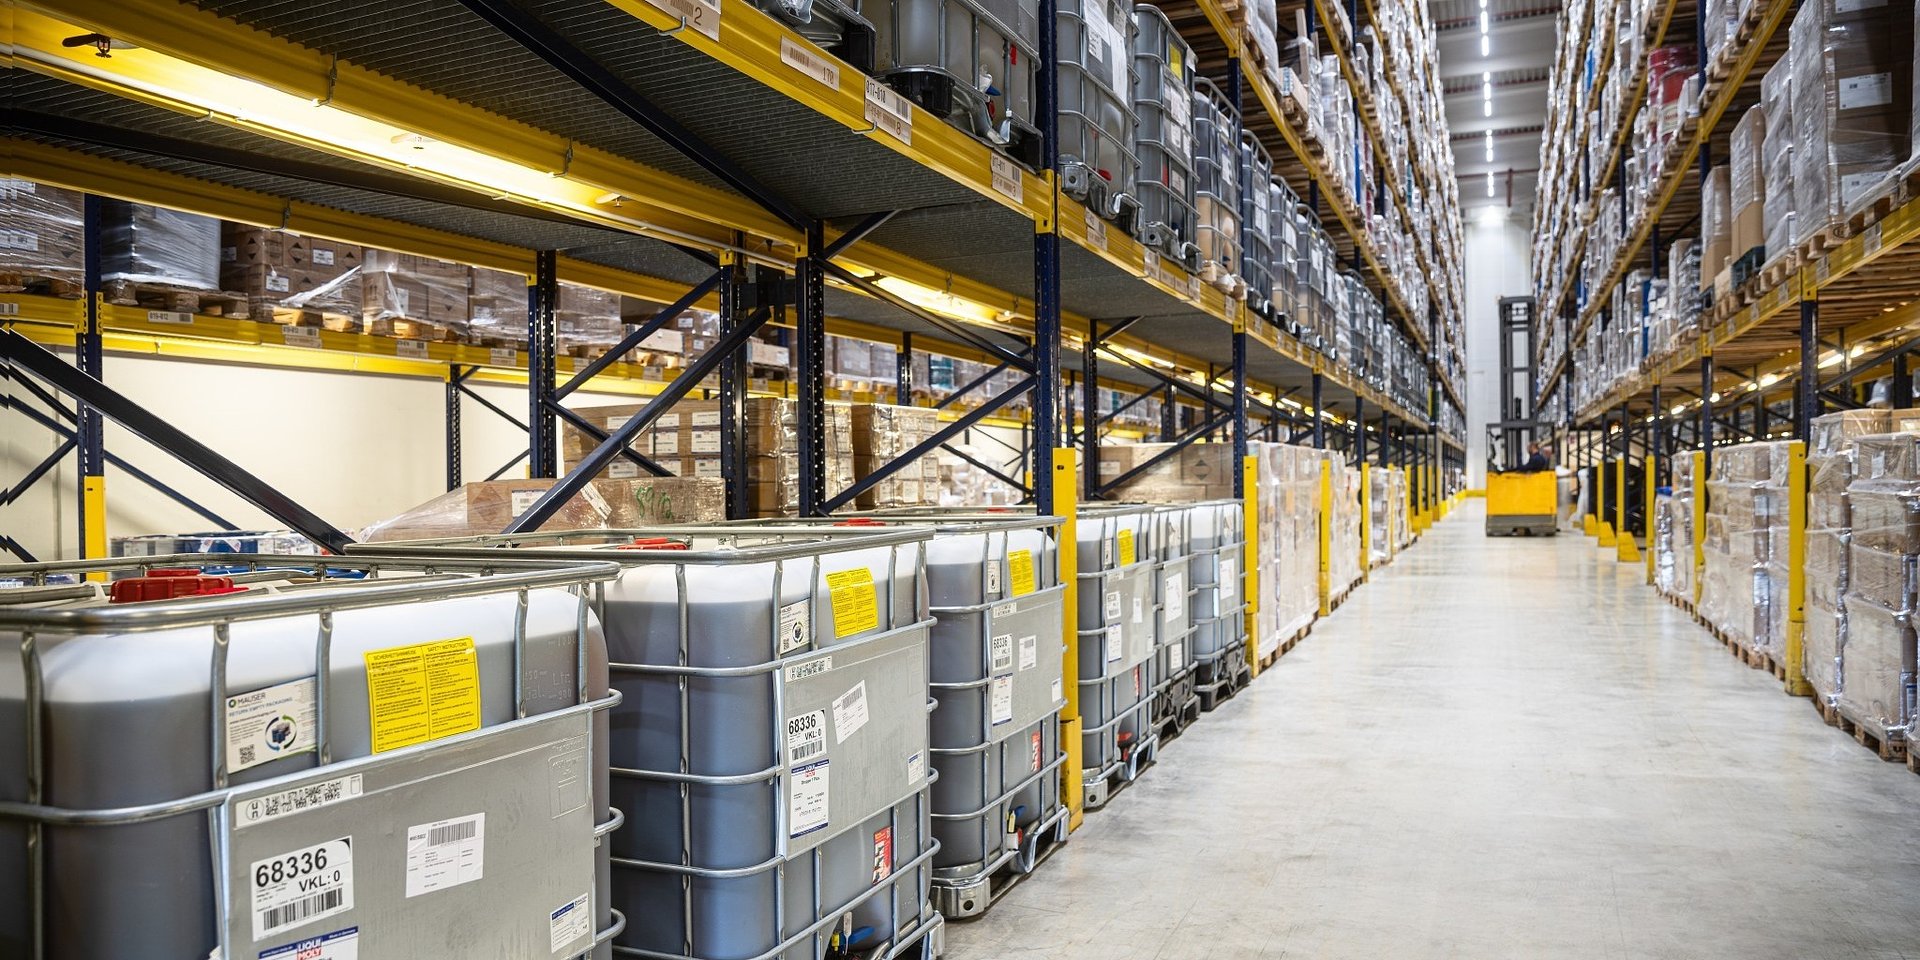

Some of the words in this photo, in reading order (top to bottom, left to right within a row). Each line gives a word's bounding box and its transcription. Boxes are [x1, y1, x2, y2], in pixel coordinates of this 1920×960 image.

[694, 6, 702, 26] 2
[788, 714, 816, 735] 68336
[804, 731, 818, 741] VKL:
[256, 848, 327, 888] 68336
[299, 875, 331, 892] VKL:
[333, 870, 341, 882] 0
[297, 938, 322, 951] LIQUI
